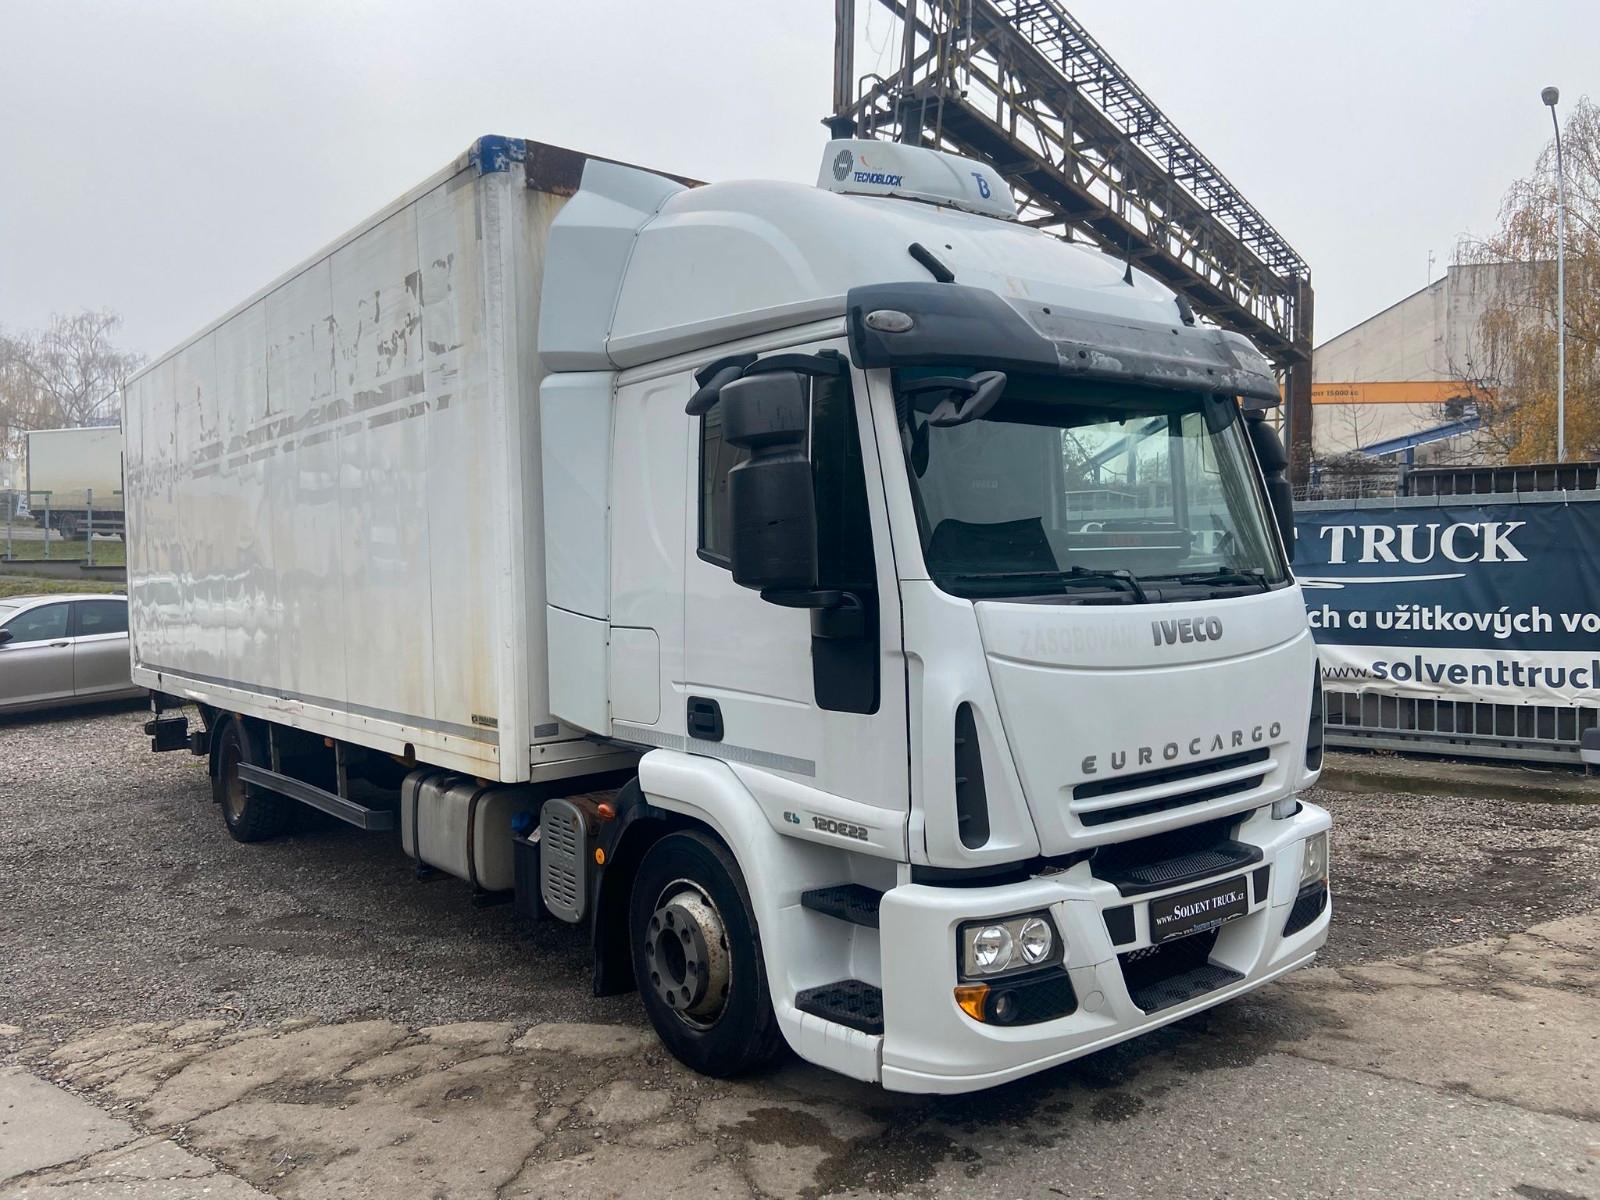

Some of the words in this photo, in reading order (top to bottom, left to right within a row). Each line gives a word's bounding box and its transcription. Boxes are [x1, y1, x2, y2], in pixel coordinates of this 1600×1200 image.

[853, 171, 903, 187] TECNOBLOCK
[1320, 521, 1528, 564] TRUCK
[1151, 615, 1223, 647] IVECO
[1305, 604, 1340, 628] ch
[1348, 611, 1367, 629] a
[1376, 604, 1553, 639] užitkových
[1081, 721, 1282, 775] EUROCARGO
[812, 816, 869, 842] 120E22
